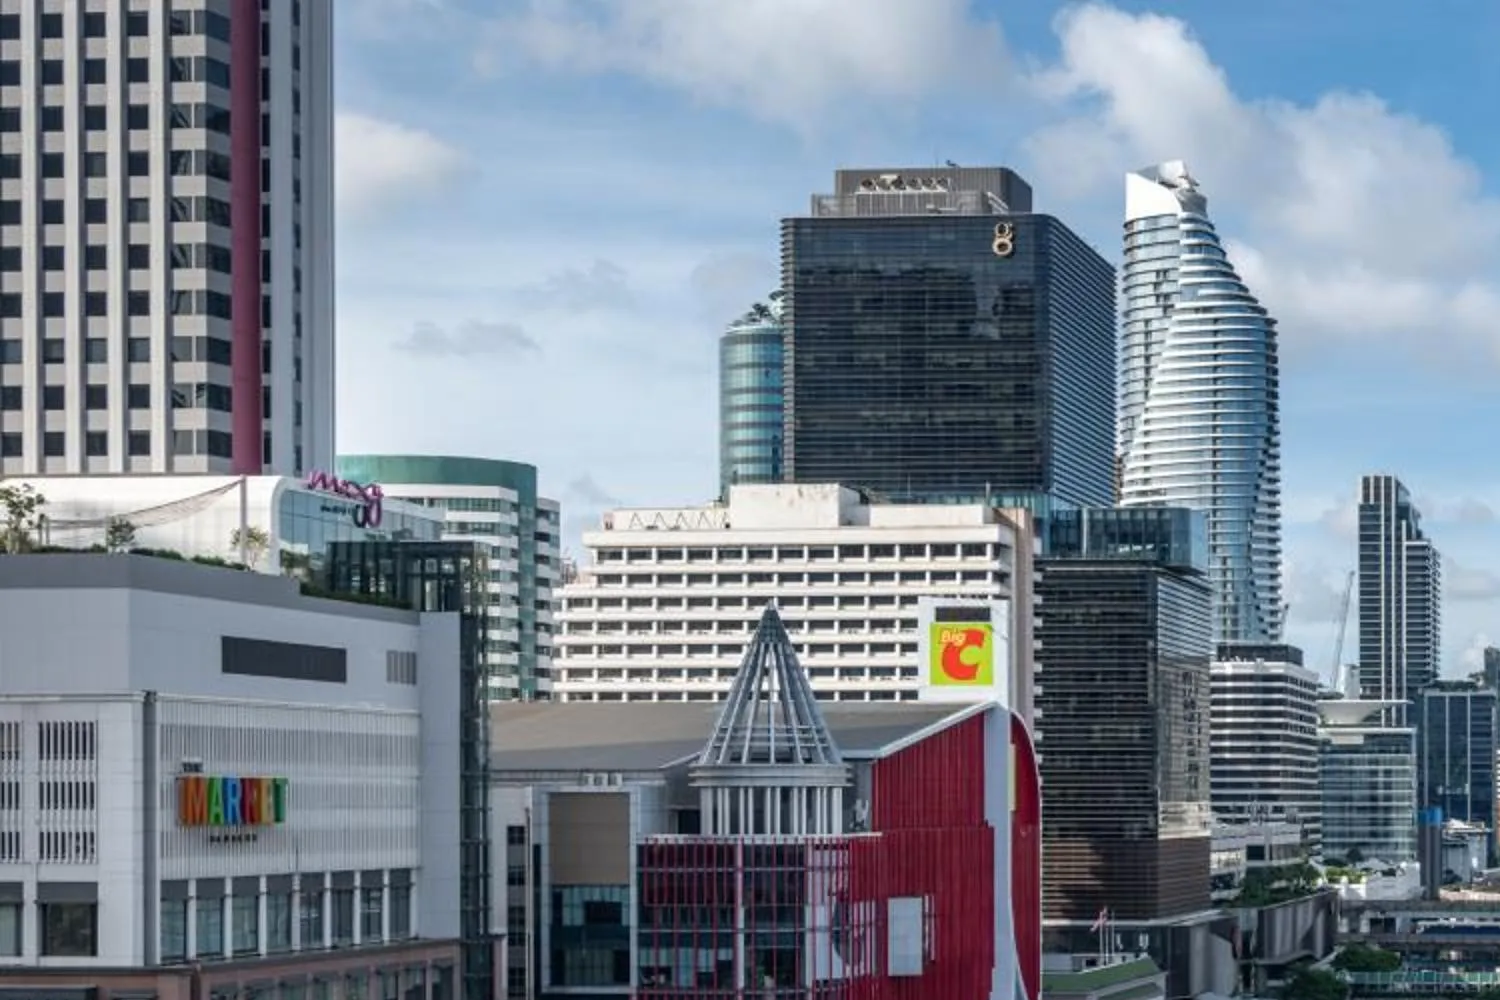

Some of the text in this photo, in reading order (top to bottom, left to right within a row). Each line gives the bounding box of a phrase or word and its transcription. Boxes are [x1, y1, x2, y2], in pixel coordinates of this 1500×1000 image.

[940, 629, 967, 647] Big
[941, 627, 985, 682] C
[176, 776, 289, 827] MARKET
